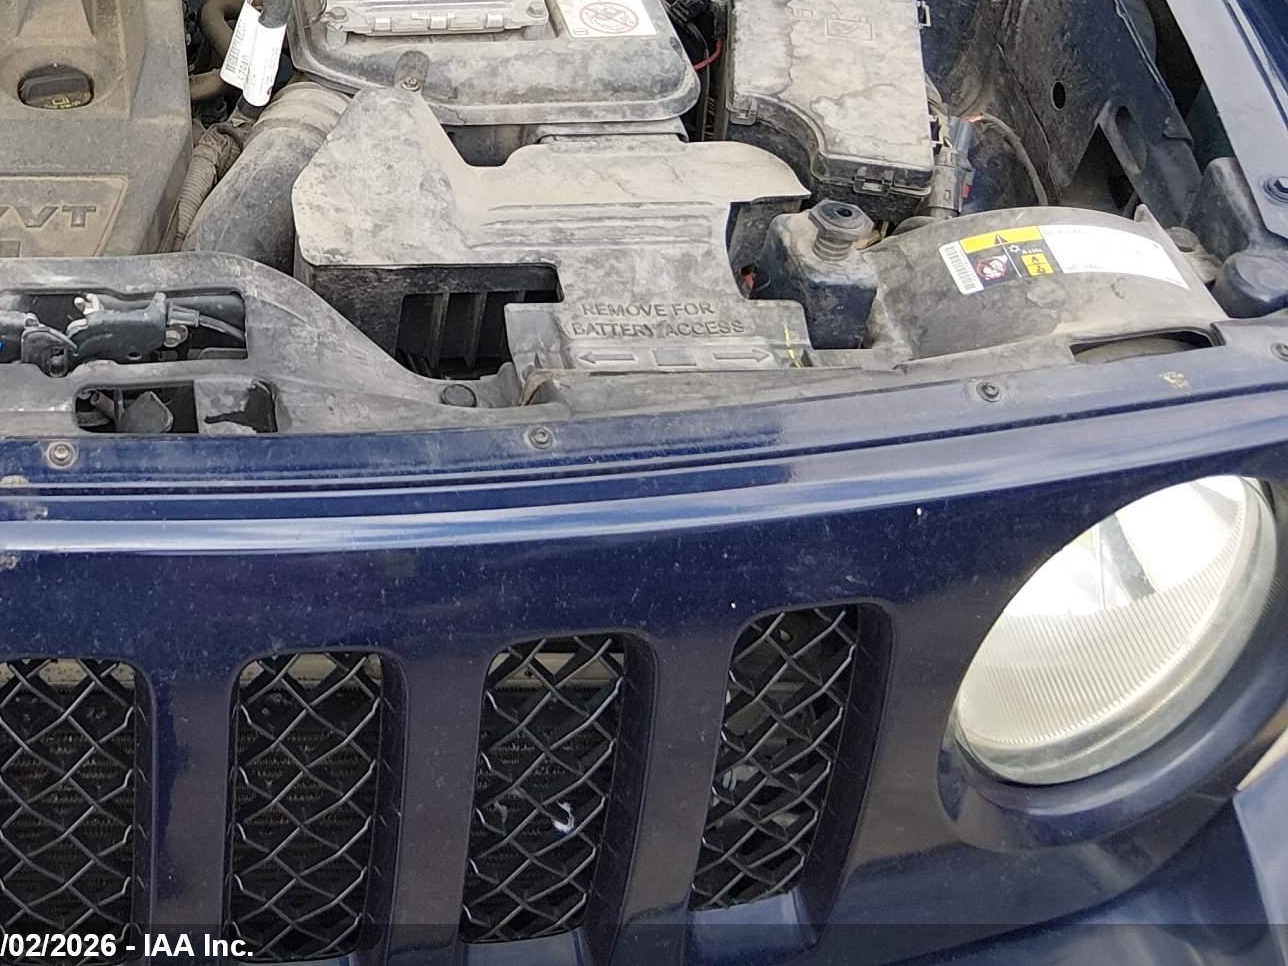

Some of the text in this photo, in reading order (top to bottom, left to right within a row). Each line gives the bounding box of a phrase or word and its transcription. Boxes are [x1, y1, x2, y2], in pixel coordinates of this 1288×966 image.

[581, 301, 715, 317] REMOVE FOR
[571, 319, 745, 337] BATTERY ACCESS
